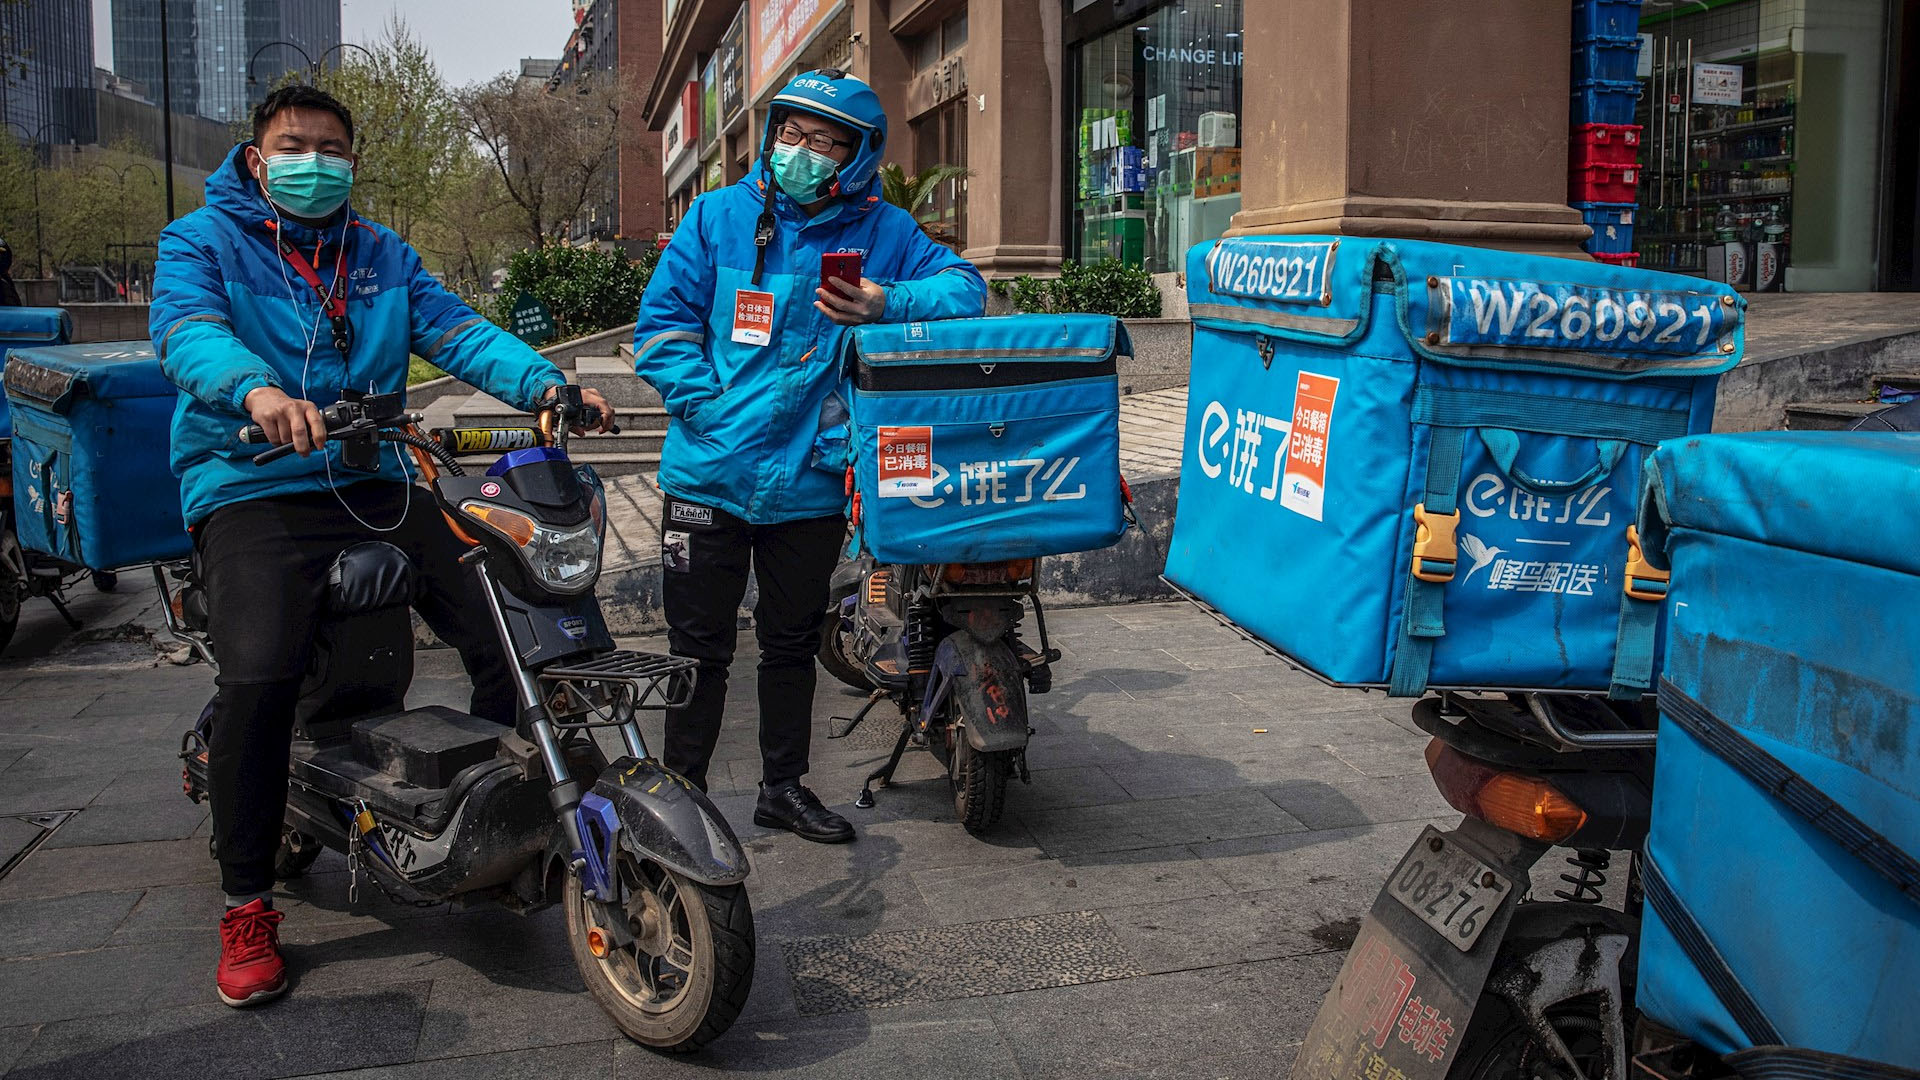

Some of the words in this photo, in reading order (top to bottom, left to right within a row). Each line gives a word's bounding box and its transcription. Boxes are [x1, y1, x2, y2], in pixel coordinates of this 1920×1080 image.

[1143, 46, 1215, 64] CHANGE
[1217, 251, 1318, 298] W260921
[738, 312, 770, 324] 检测正常
[739, 303, 771, 315] 今日体温
[1469, 287, 1713, 345] W260921
[1295, 406, 1328, 435] 今日餐箱
[884, 443, 927, 454] 今日餐箱
[1291, 432, 1324, 468] 已消毒
[884, 456, 928, 471] 已消毒
[1487, 558, 1599, 595] 蜂鸟配送
[563, 619, 583, 628] SPORT
[1399, 860, 1485, 938] 08276
[1398, 996, 1454, 1063] 电动车
